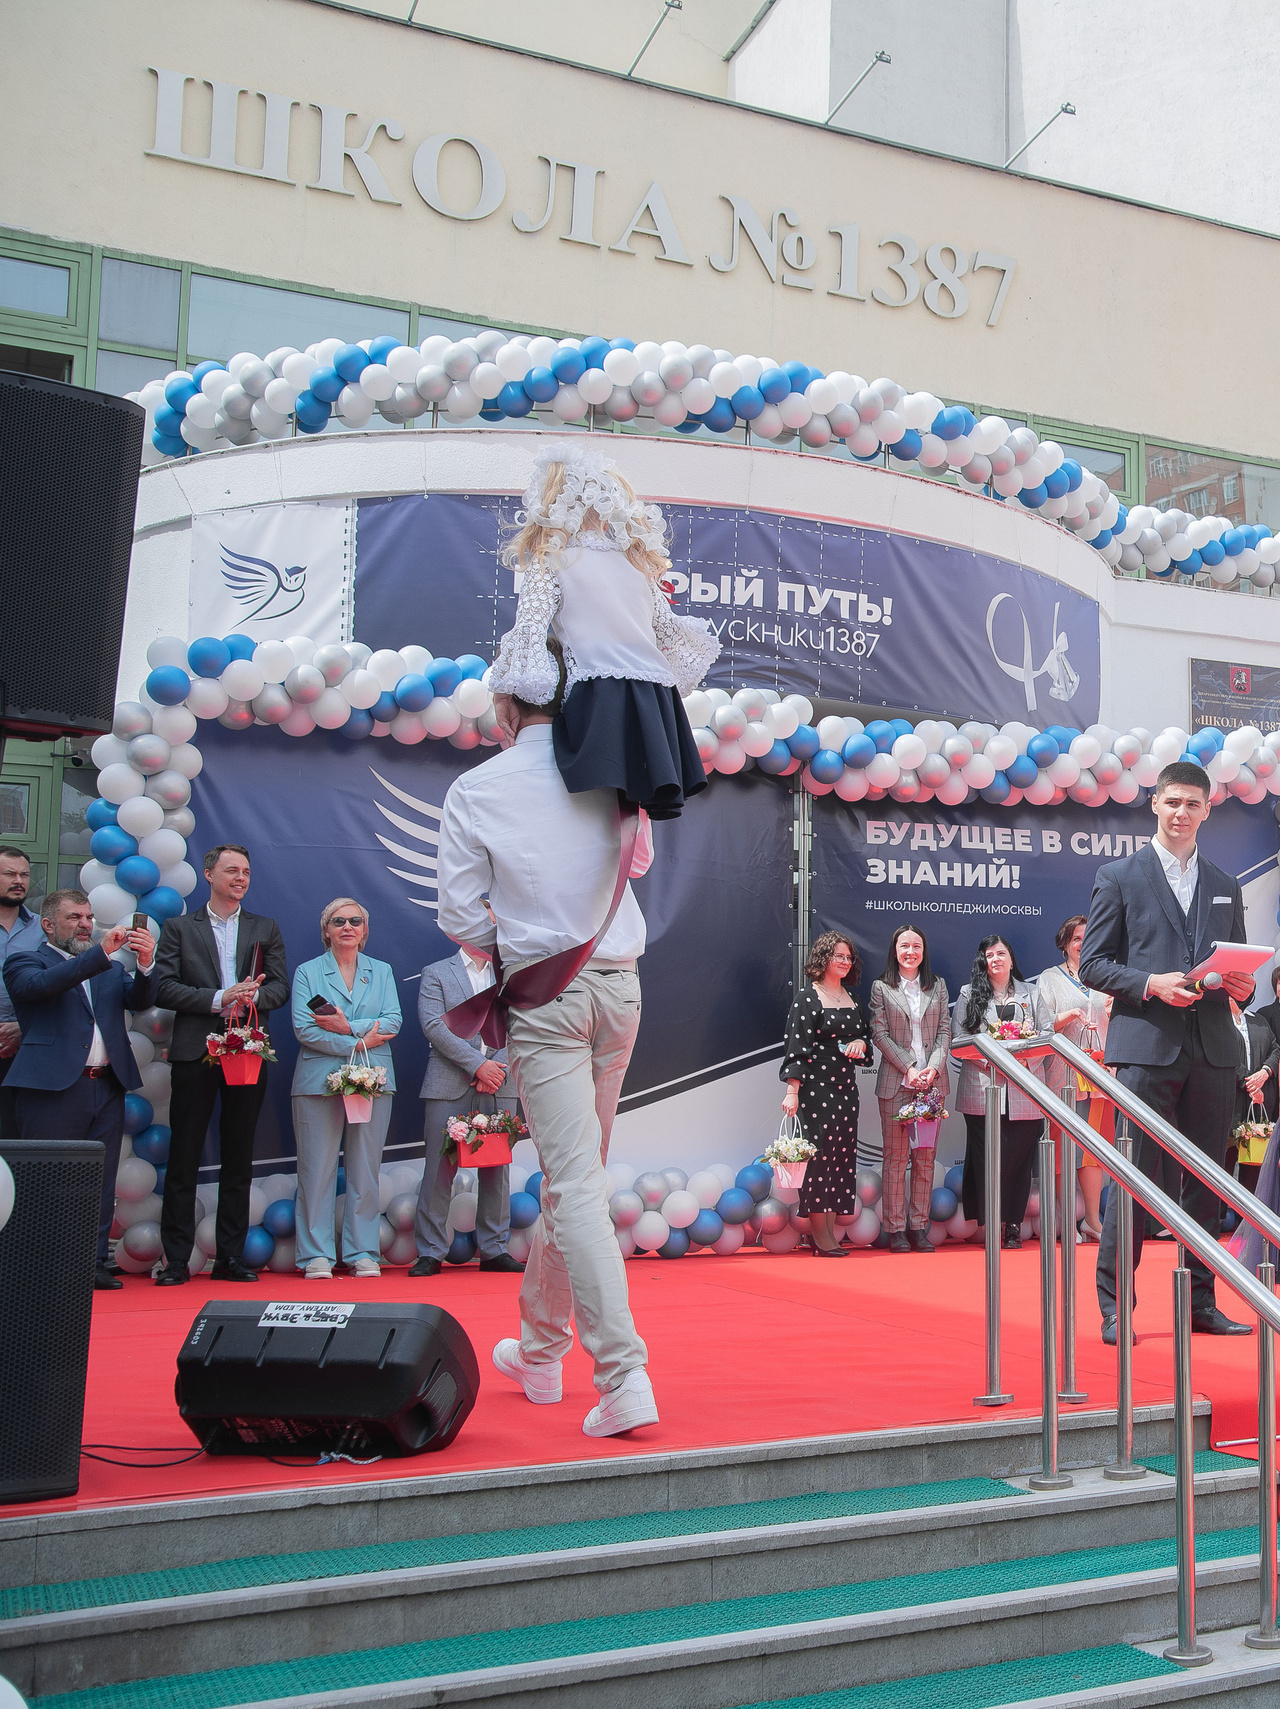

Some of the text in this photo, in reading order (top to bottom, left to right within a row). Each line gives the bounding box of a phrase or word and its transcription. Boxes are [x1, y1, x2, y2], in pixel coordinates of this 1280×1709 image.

[143, 66, 694, 268] ШКОЛА
[665, 568, 893, 626] РЫЙ ПУТЬ!
[709, 616, 881, 659] ускники1387
[865, 820, 1033, 854] БУДУЩЕЕ
[1041, 829, 1063, 853] В
[865, 857, 1021, 889] ЗНАНИЙ!
[864, 900, 1042, 916] #ШКОЛЫКОЛЛЕДЖИМОСКВЫ
